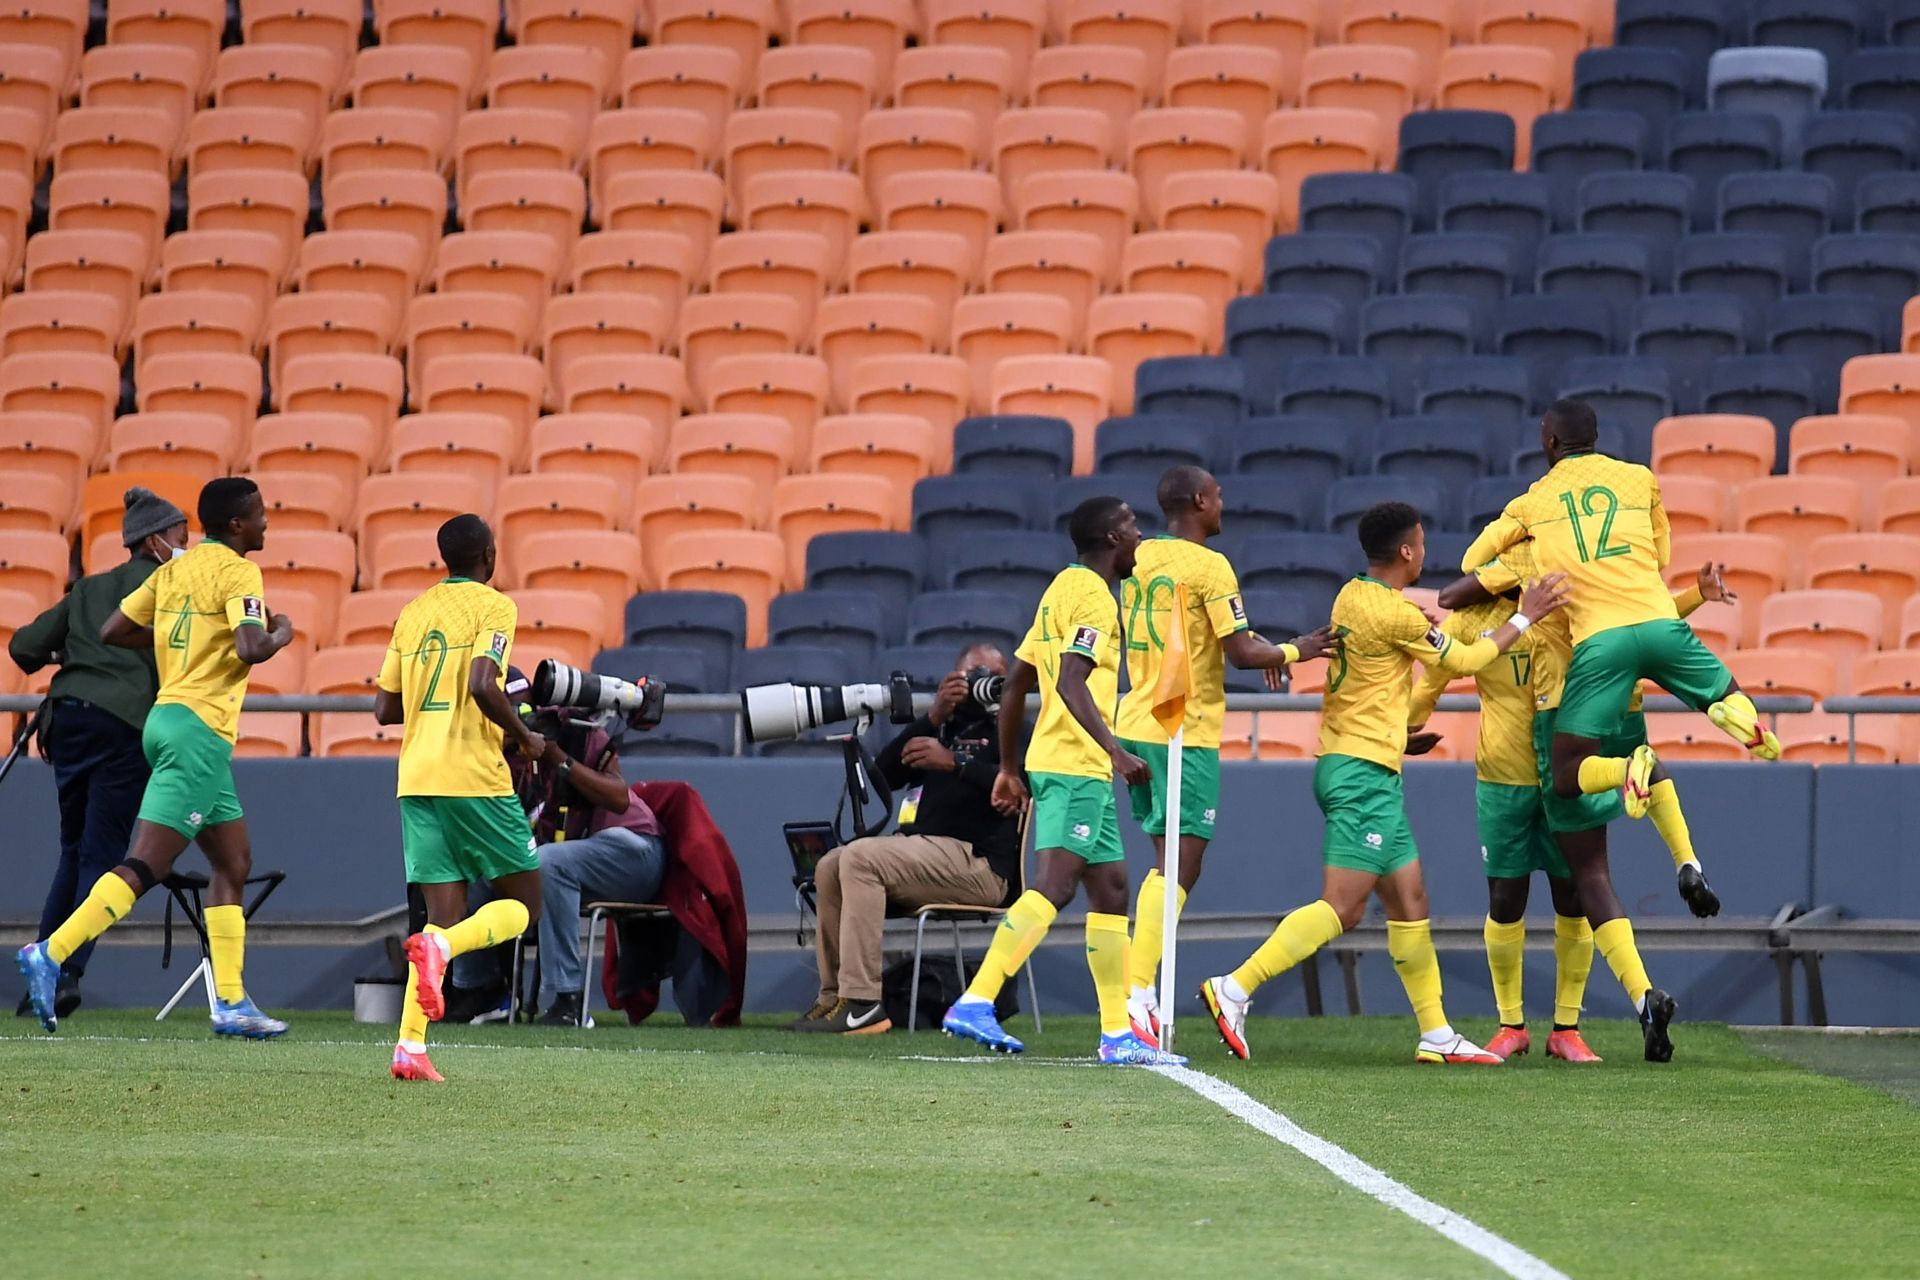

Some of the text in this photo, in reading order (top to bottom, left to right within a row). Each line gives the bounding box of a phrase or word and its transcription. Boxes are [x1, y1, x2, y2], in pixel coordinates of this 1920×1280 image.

[1559, 485, 1631, 563] 12
[169, 594, 192, 672] 4
[419, 629, 449, 711] 2
[1510, 654, 1531, 686] 17
